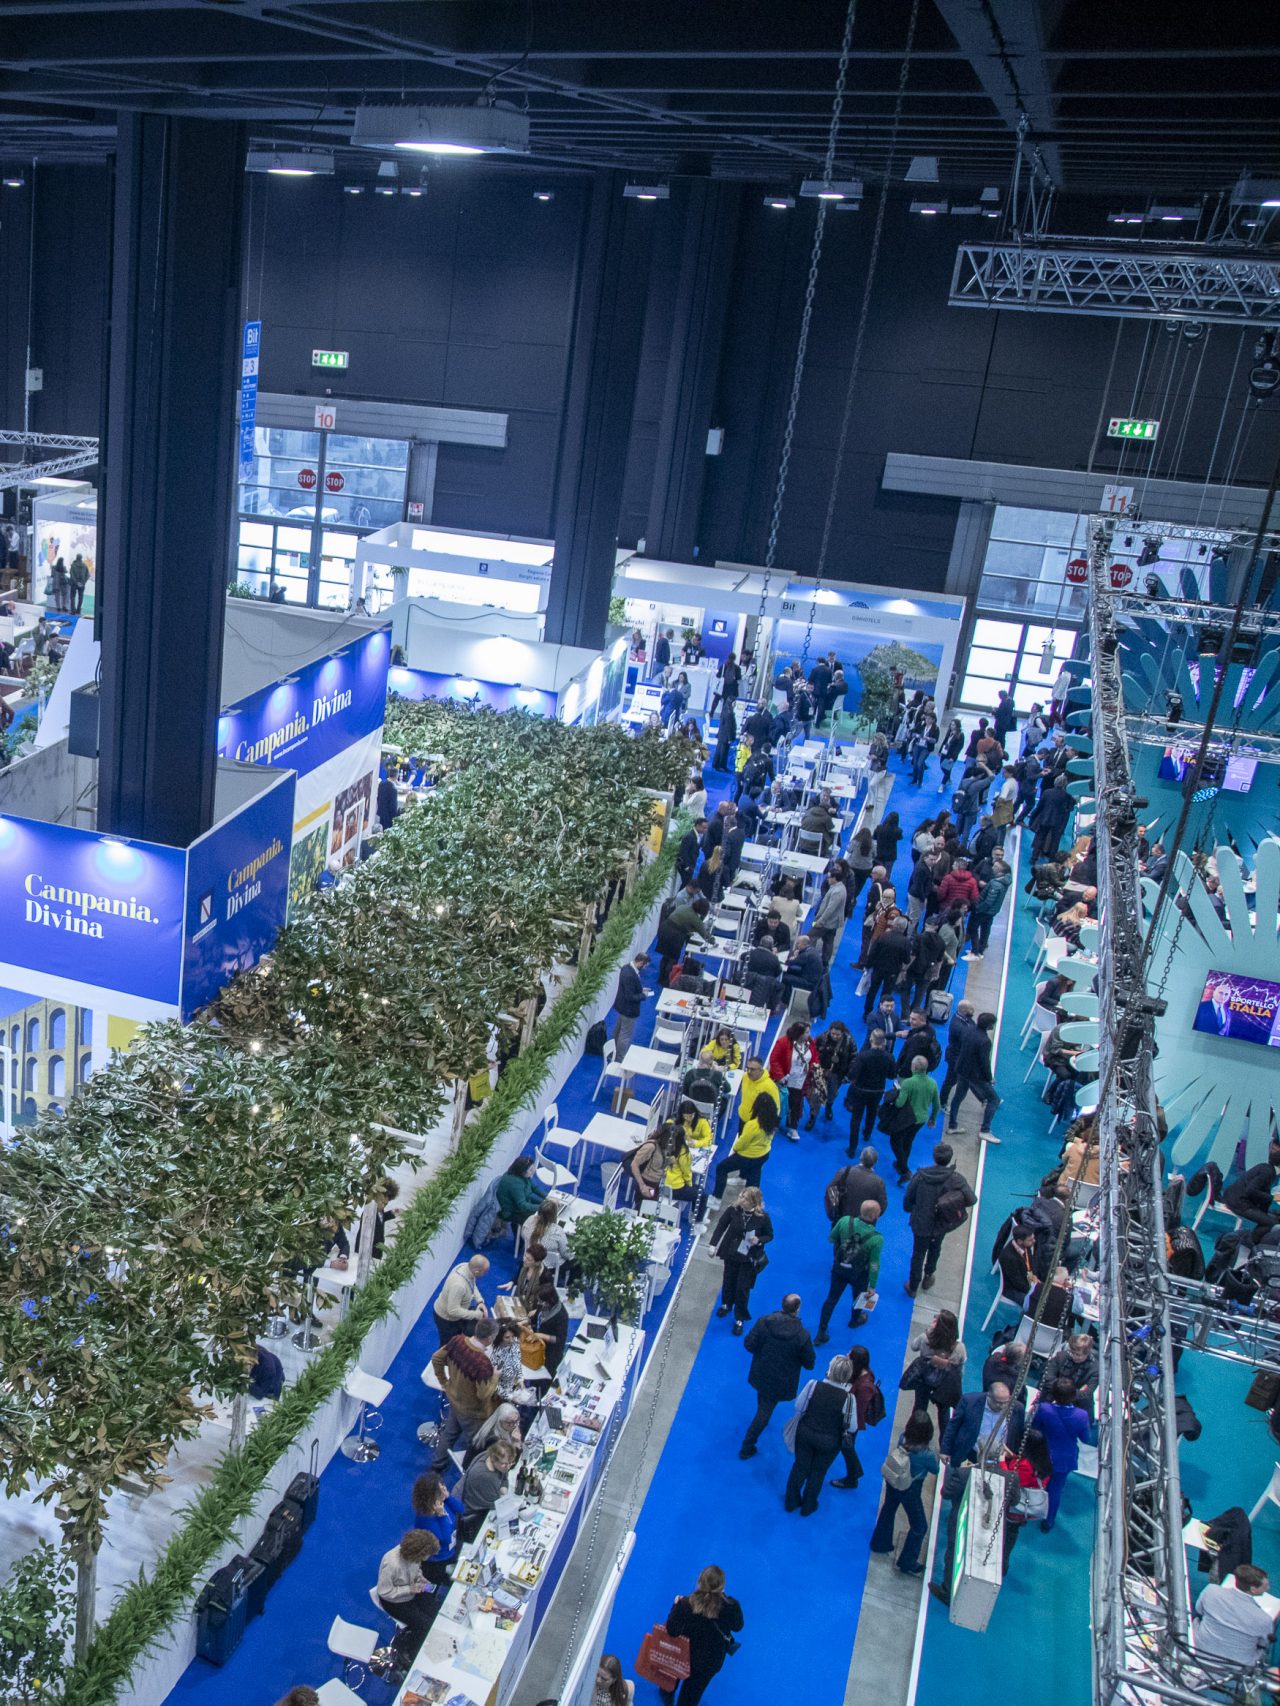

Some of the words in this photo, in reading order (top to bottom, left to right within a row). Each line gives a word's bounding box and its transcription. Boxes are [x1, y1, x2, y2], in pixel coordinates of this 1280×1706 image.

[247, 328, 259, 344] Bit
[318, 413, 334, 428] 10
[298, 474, 316, 484] STOP
[326, 477, 344, 487] STOP
[1107, 494, 1128, 513] 11
[1066, 565, 1088, 577] STO
[782, 601, 796, 611] Bit
[235, 711, 310, 765] Campania.
[311, 689, 352, 728] Divina
[227, 837, 284, 893] Campania.
[24, 873, 160, 925] Campania.
[226, 880, 262, 921] Divina
[24, 899, 105, 939] Divina
[1229, 1001, 1272, 1018] ITALIA
[1230, 996, 1275, 1010] SPORTELLO
